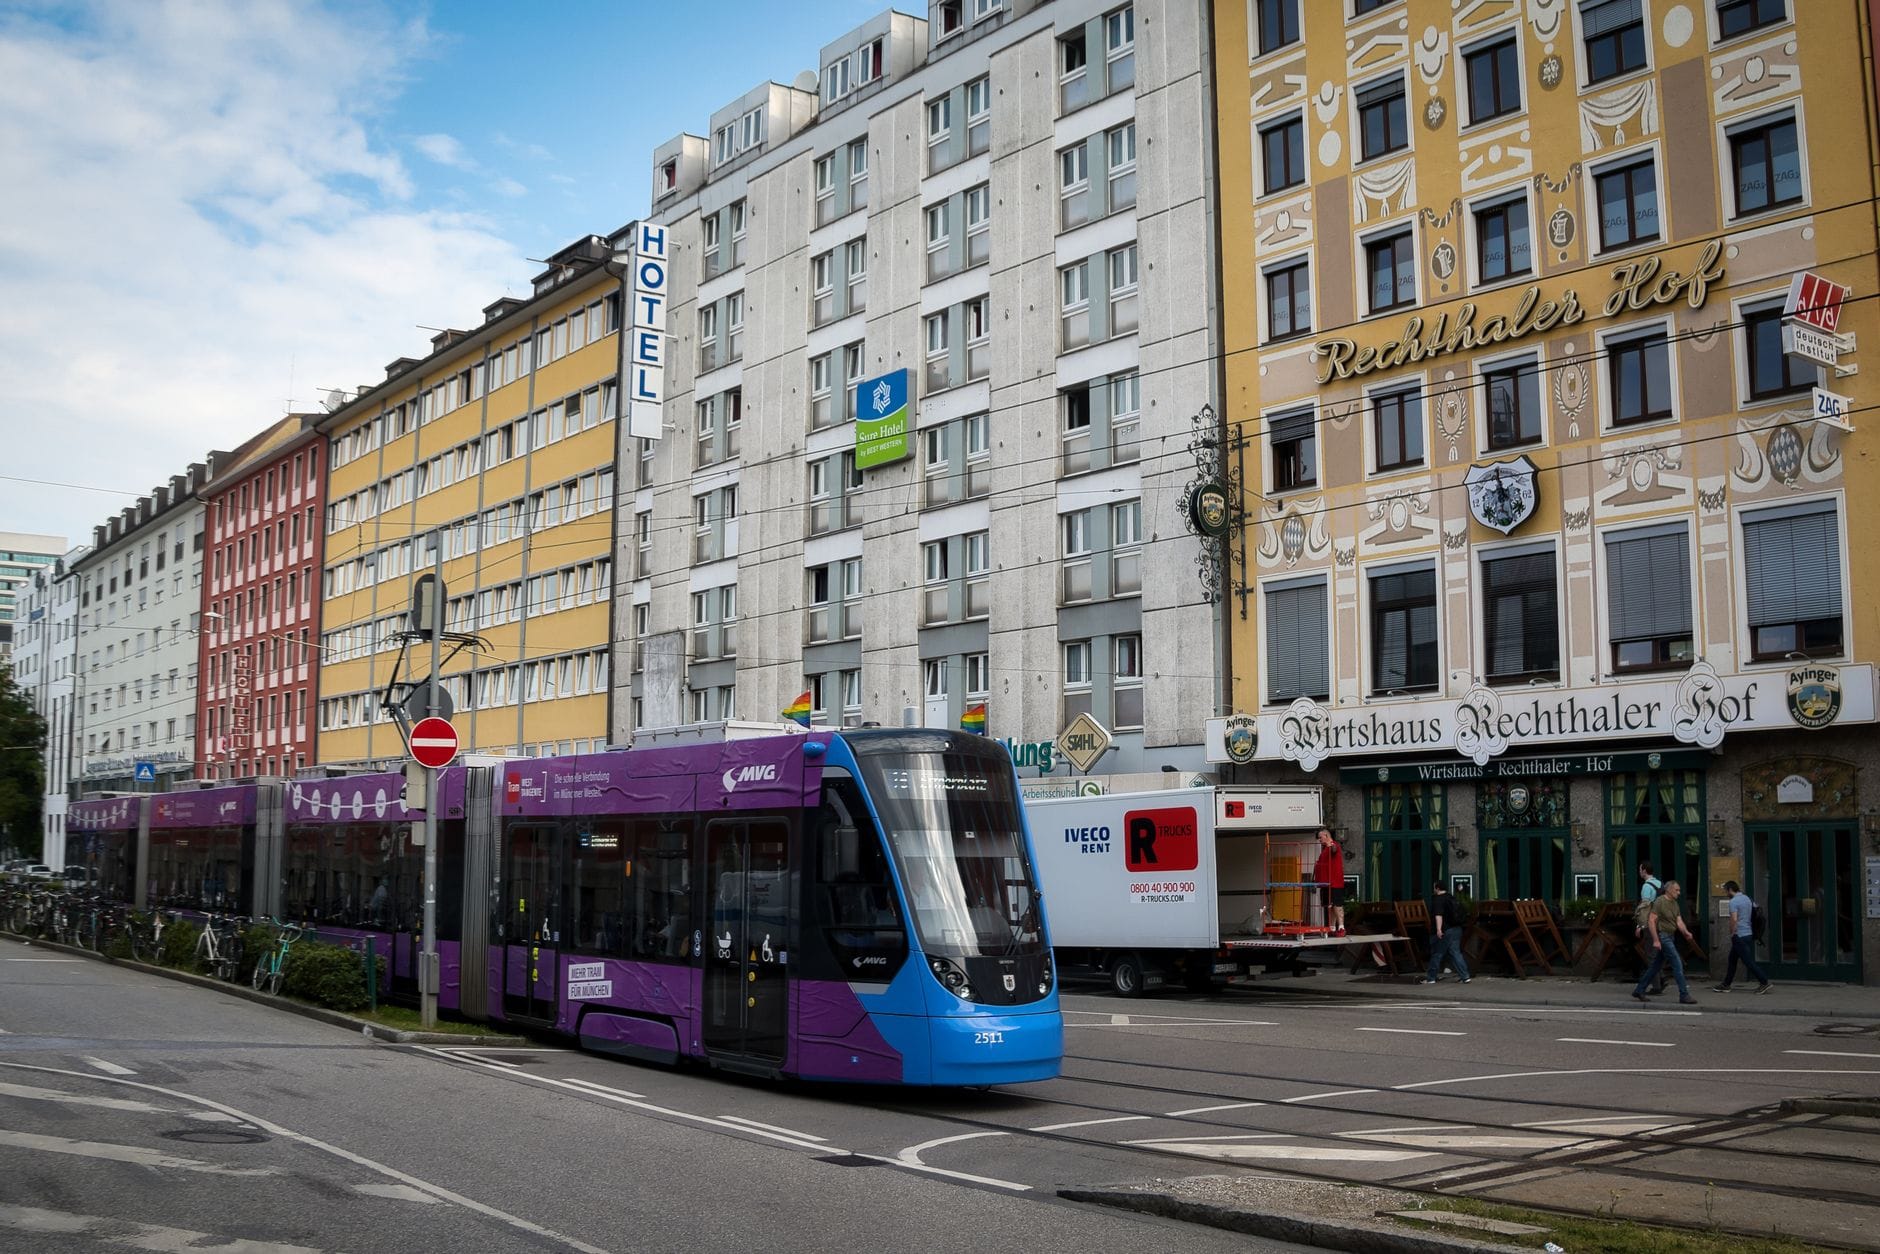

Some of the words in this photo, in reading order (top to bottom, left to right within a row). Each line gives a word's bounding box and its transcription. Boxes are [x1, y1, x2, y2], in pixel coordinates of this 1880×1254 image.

[638, 226, 664, 398] HOTEL
[1315, 286, 1584, 384] Rechthaler
[1602, 239, 1724, 317] Hof
[1796, 329, 1834, 351] deutsch
[1796, 340, 1834, 362] institut
[1818, 394, 1841, 420] ZAG
[860, 432, 878, 442] Sure
[880, 420, 904, 438] Hotel
[1790, 667, 1837, 685] Ayinger
[237, 656, 249, 747] HOTEL
[1226, 715, 1256, 729] Ayinger
[1282, 711, 1442, 750] Wirtshaus
[1457, 694, 1660, 743] Rechthaler
[1676, 682, 1758, 734] Hof
[1068, 734, 1097, 751] STAHL
[737, 764, 776, 782] MVG
[1418, 764, 1483, 780] Wirtshaus
[1499, 759, 1570, 777] Rechthaler
[1587, 756, 1614, 772] Hof
[1022, 787, 1076, 798] Arbeitsschuhe
[1065, 826, 1110, 842] IVECO
[1158, 825, 1192, 837] TRUCKS
[1081, 843, 1110, 854] RENT
[1130, 817, 1158, 864] R
[1130, 883, 1150, 893] 0800
[1151, 883, 1161, 893] 40
[1163, 882, 1178, 892] 900
[1179, 882, 1194, 892] 900
[1141, 894, 1184, 903] R-TRUCKS.COM
[571, 967, 587, 979] MEHR
[587, 966, 602, 978] TRAM
[571, 983, 581, 997] FÜR
[582, 983, 609, 997] MÜNCHEN
[975, 1032, 1004, 1044] 2511
